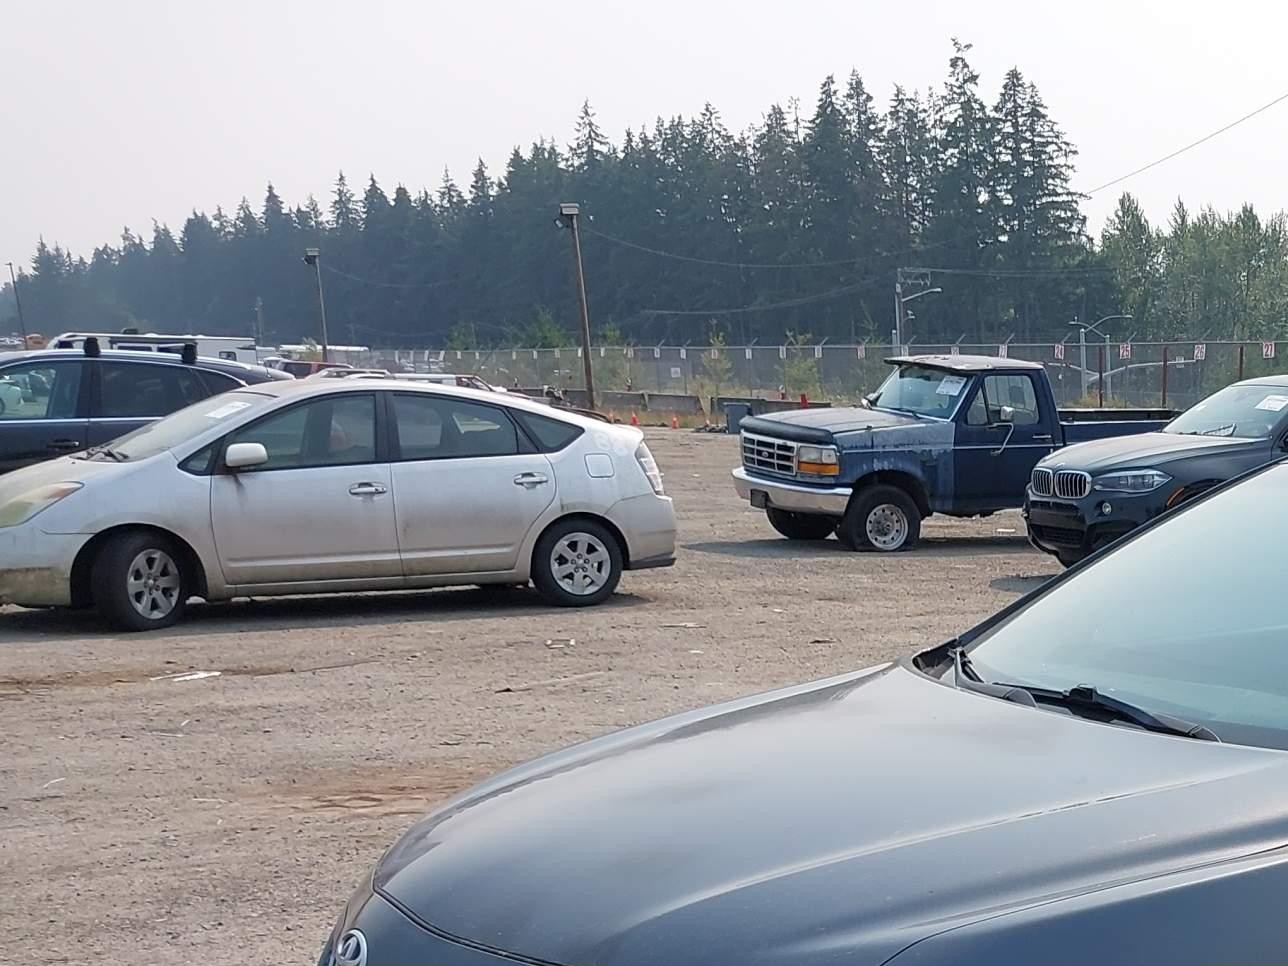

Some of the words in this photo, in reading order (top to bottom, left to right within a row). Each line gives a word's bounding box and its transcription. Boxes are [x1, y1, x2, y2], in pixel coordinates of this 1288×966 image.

[1120, 344, 1130, 358] 25
[1195, 345, 1205, 358] 26
[1264, 343, 1273, 357] 27
